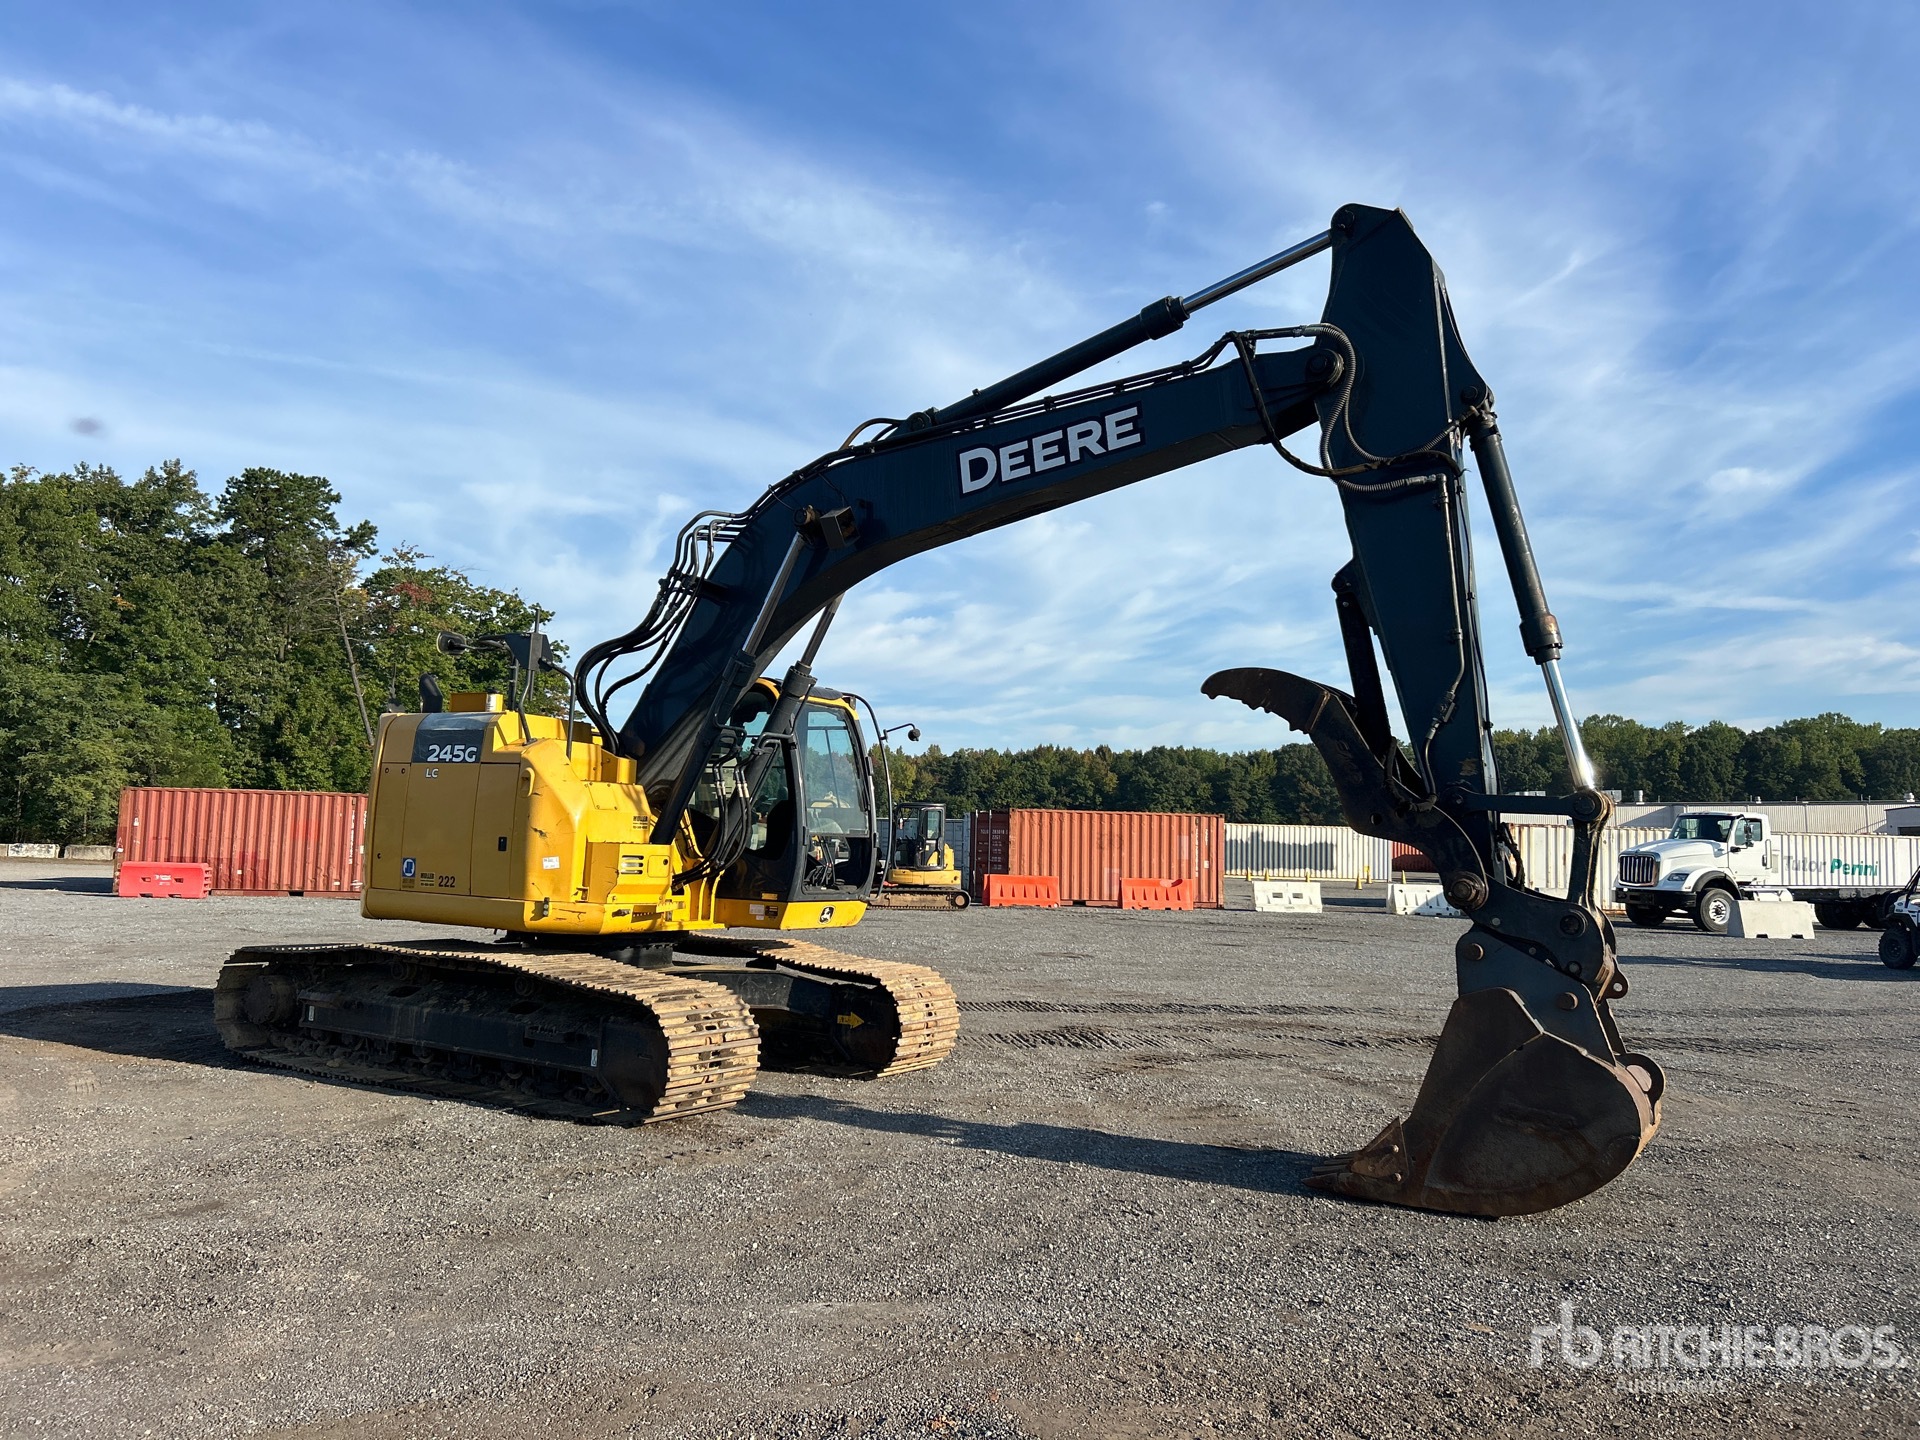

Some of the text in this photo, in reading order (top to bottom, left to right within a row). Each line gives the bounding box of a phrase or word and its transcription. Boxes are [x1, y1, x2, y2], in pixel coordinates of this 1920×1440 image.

[959, 406, 1141, 494] DEERE
[426, 744, 478, 763] 245G
[425, 768, 439, 778] LC
[1784, 855, 1879, 876] Tutor Perini
[438, 875, 456, 888] 222
